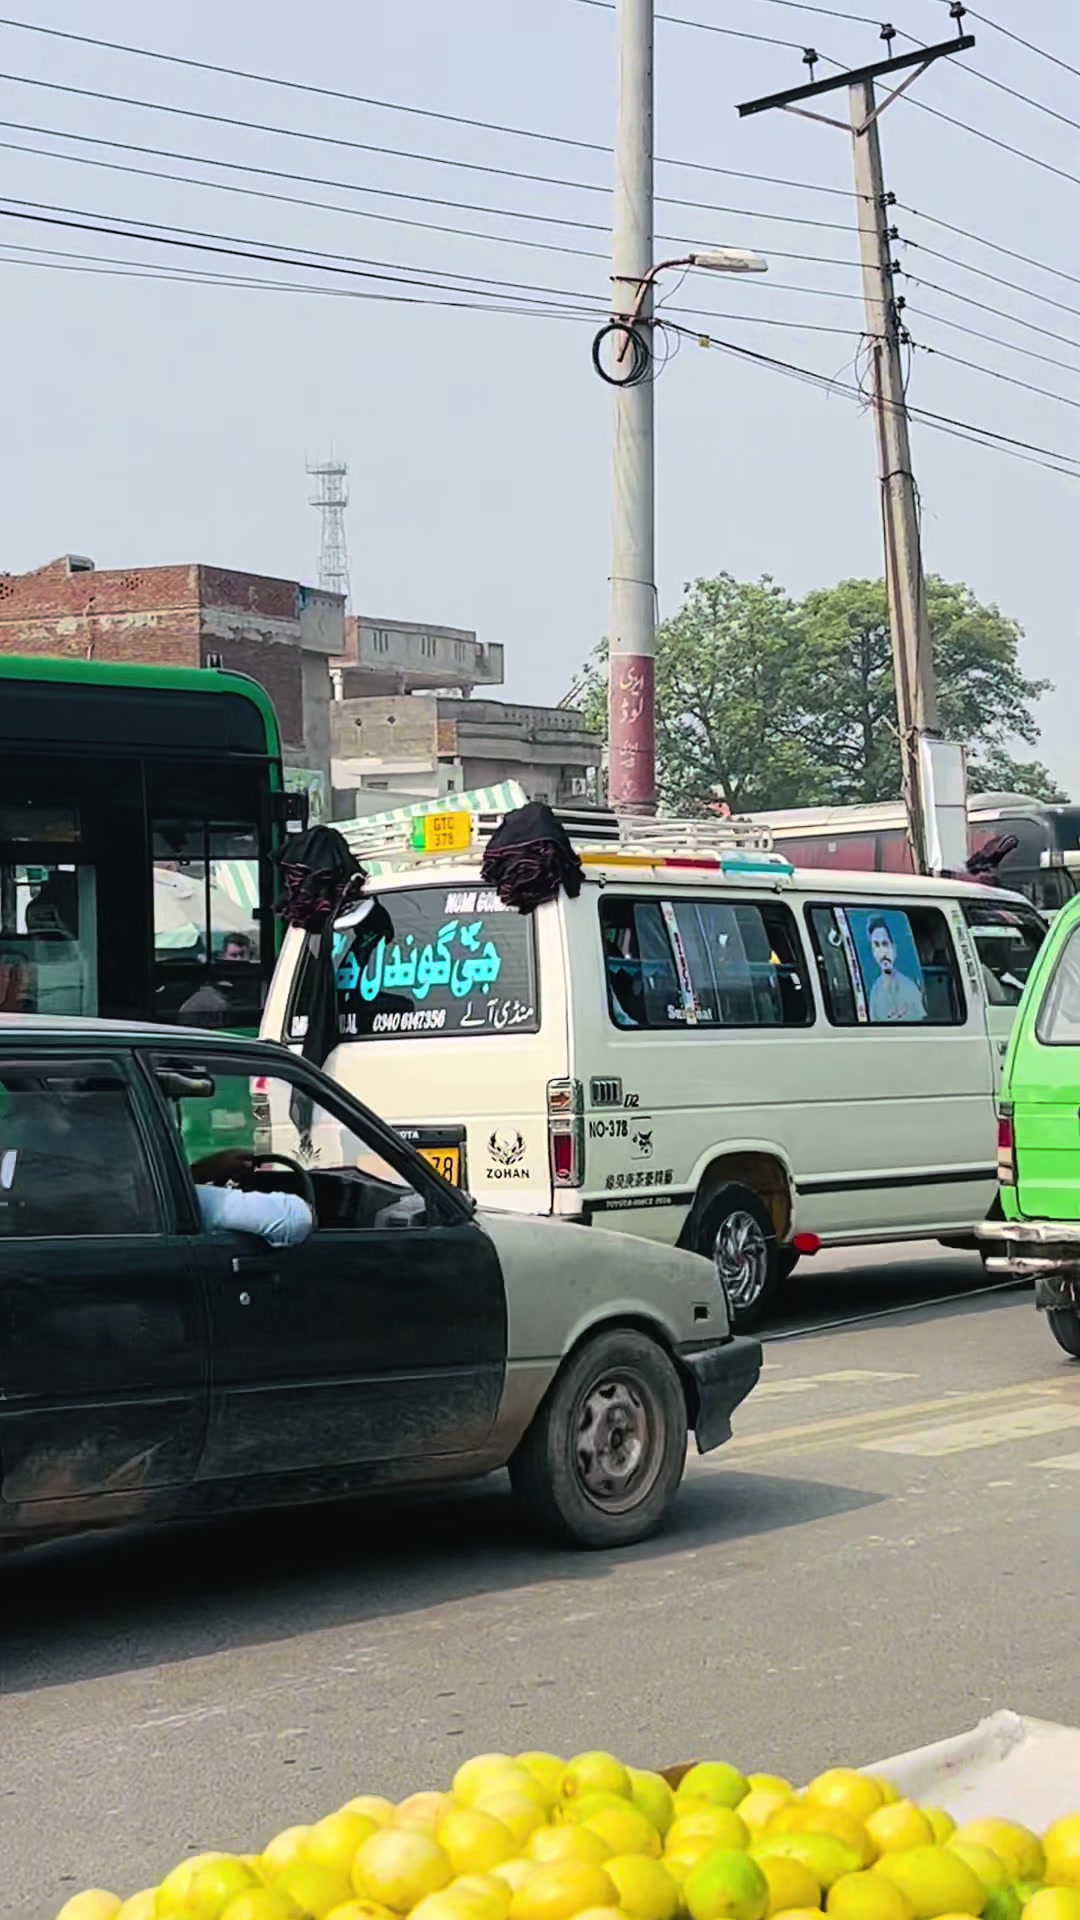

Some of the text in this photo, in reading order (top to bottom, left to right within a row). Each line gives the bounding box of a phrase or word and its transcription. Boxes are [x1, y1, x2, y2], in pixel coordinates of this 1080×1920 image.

[433, 816, 455, 831] GTC
[434, 832, 454, 847] 378
[372, 1012, 401, 1032] 0340
[589, 1119, 628, 1138] NO-378
[486, 1168, 531, 1180] ZOHAN
